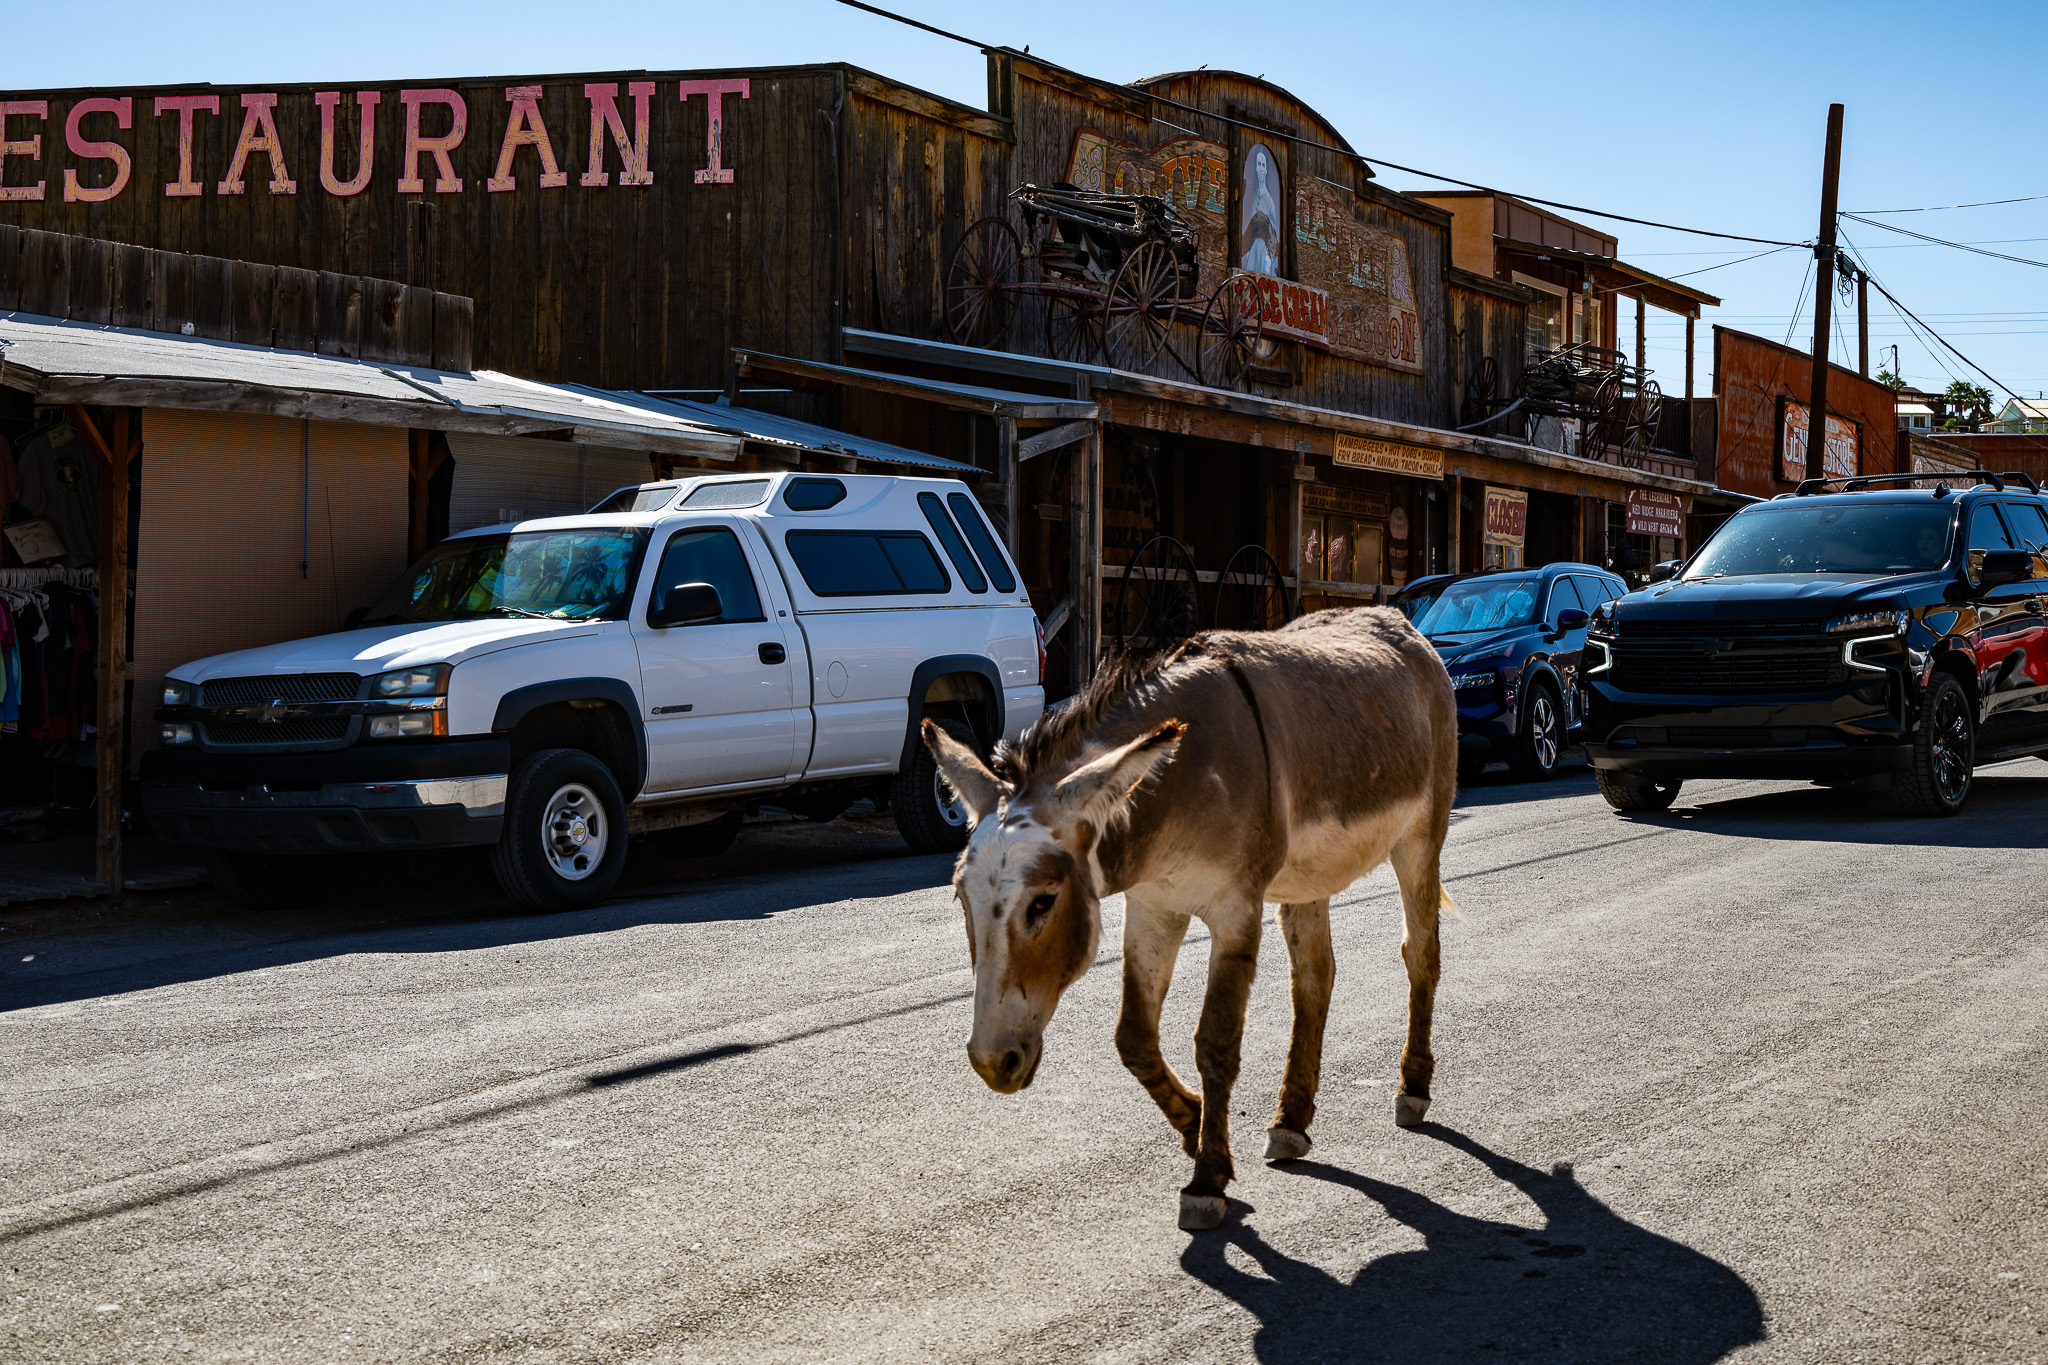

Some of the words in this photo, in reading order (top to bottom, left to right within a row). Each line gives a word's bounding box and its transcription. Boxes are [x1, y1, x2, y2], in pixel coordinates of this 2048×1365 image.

[1282, 284, 1329, 337] CREAM
[1328, 300, 1416, 363] SALOON
[1337, 450, 1351, 461] FRY
[1352, 452, 1373, 465] BREAD
[1376, 456, 1399, 469] NAVAJO
[1401, 460, 1420, 472] TACOS
[1422, 463, 1438, 475] CHILI
[1338, 436, 1384, 454] HAMBURGERS
[1388, 443, 1401, 456] HOT
[1401, 447, 1418, 459] DOGS
[1421, 450, 1441, 463] SODAS
[1827, 437, 1854, 477] STORE
[1303, 484, 1338, 498] MBURGERS
[1639, 489, 1648, 501] THE
[1648, 491, 1673, 504] LEGENDARY
[1486, 498, 1525, 536] CLOSED
[1632, 503, 1640, 515] RED
[1641, 505, 1654, 517] RIDGE
[1637, 520, 1648, 531] WILD
[1648, 521, 1659, 533] WEST
